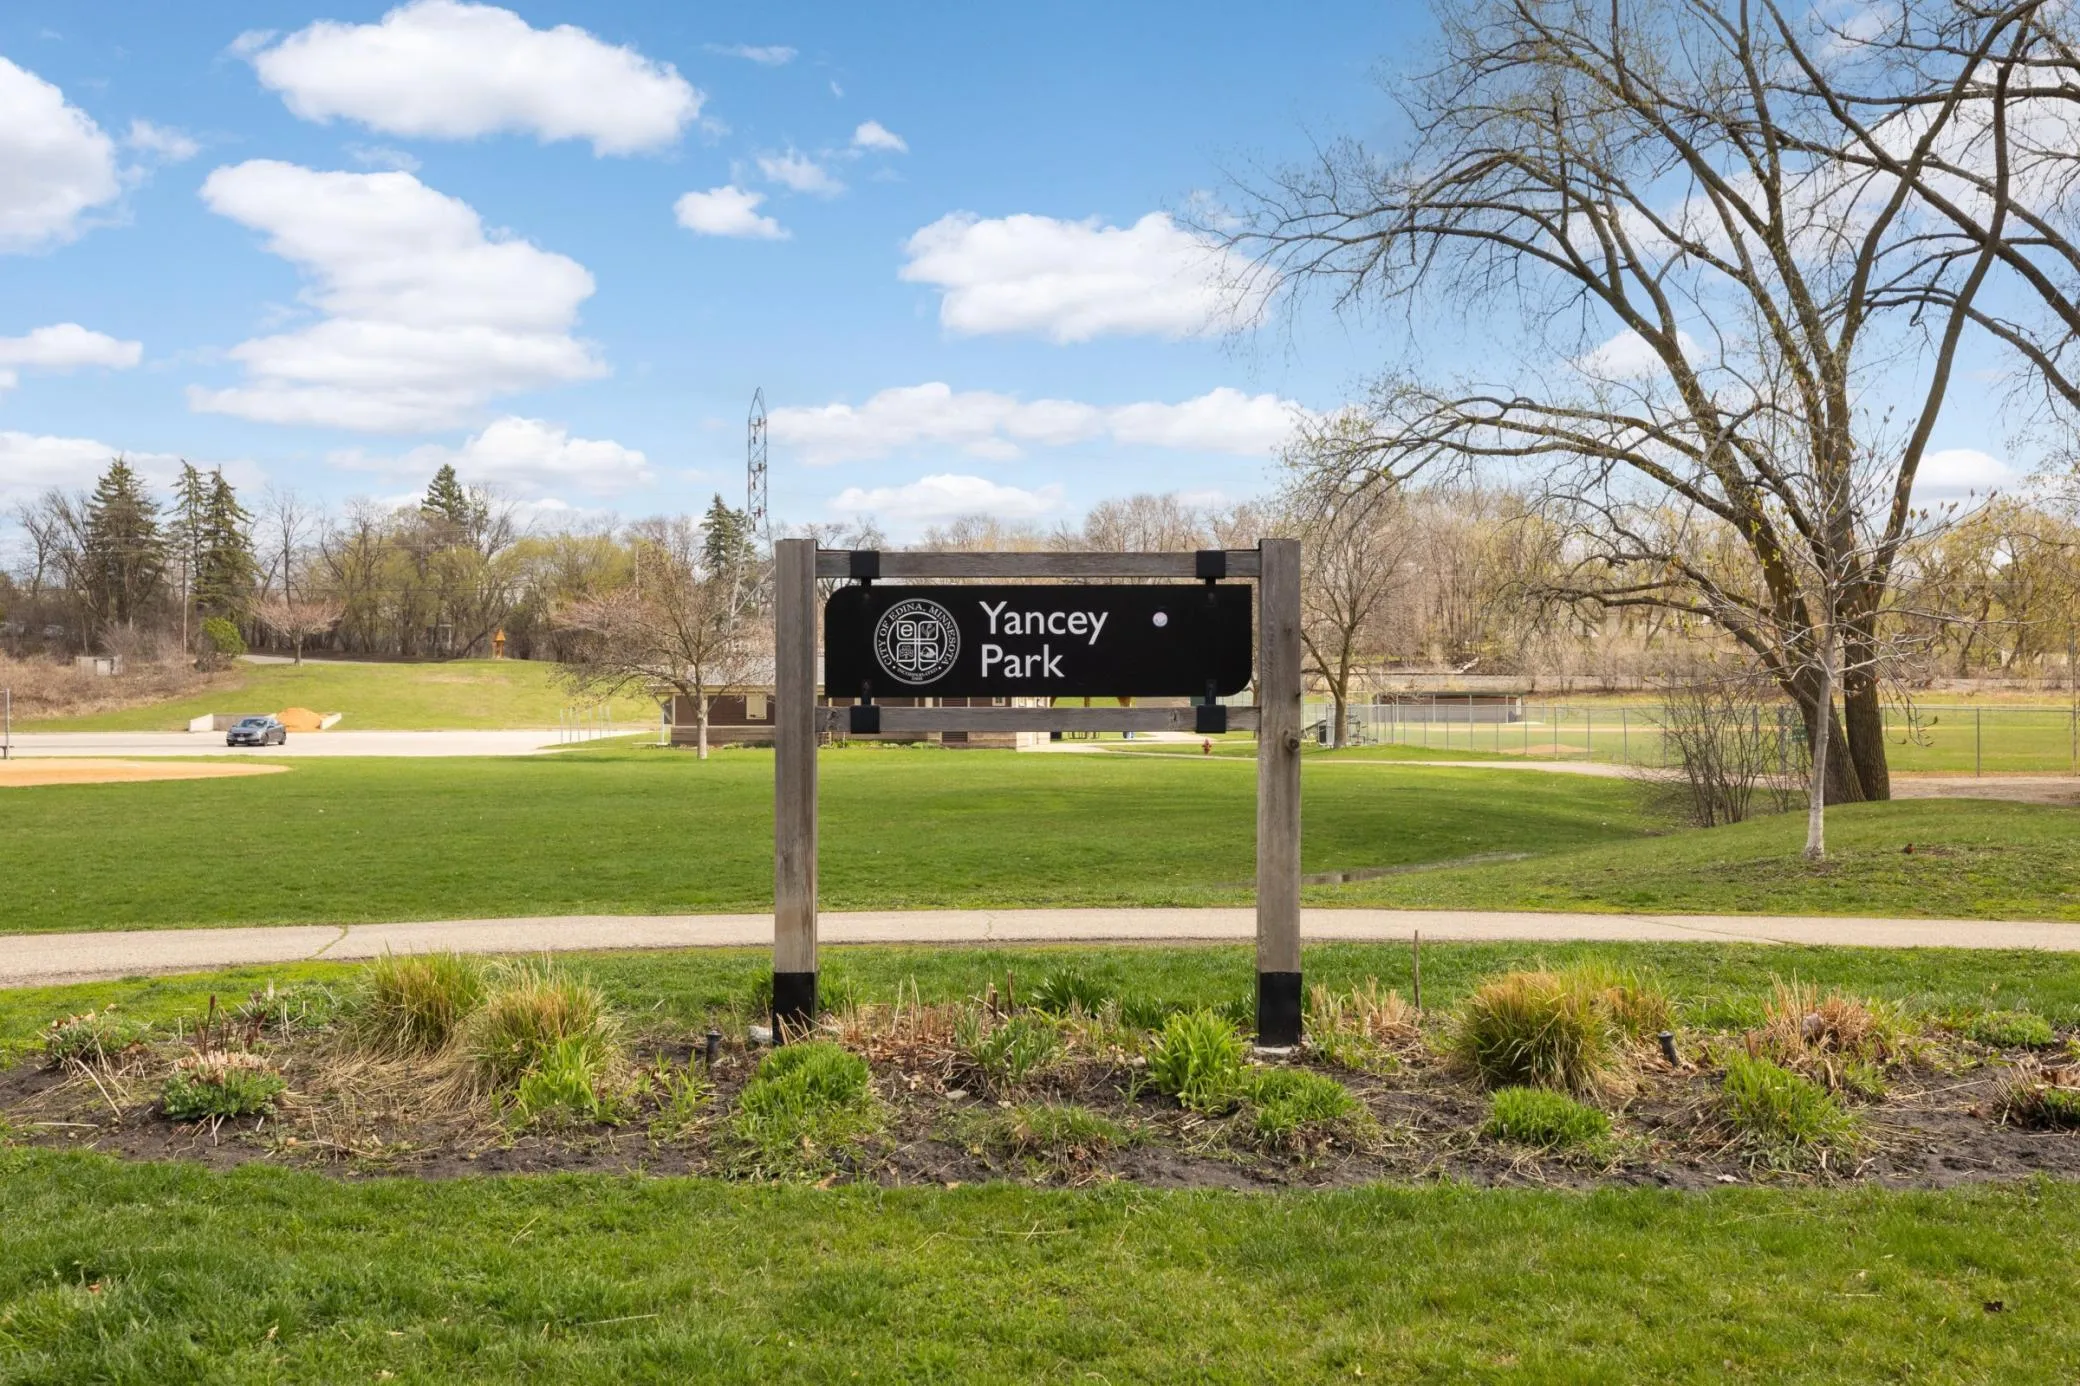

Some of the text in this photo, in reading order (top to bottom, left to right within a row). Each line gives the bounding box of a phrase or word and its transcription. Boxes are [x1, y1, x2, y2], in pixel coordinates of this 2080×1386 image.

[879, 621, 889, 636] OF
[901, 624, 913, 637] e
[929, 606, 956, 665] MINNESOTA
[979, 601, 1108, 645] Yancey
[878, 640, 892, 665] CITY
[982, 644, 1064, 677] Park
